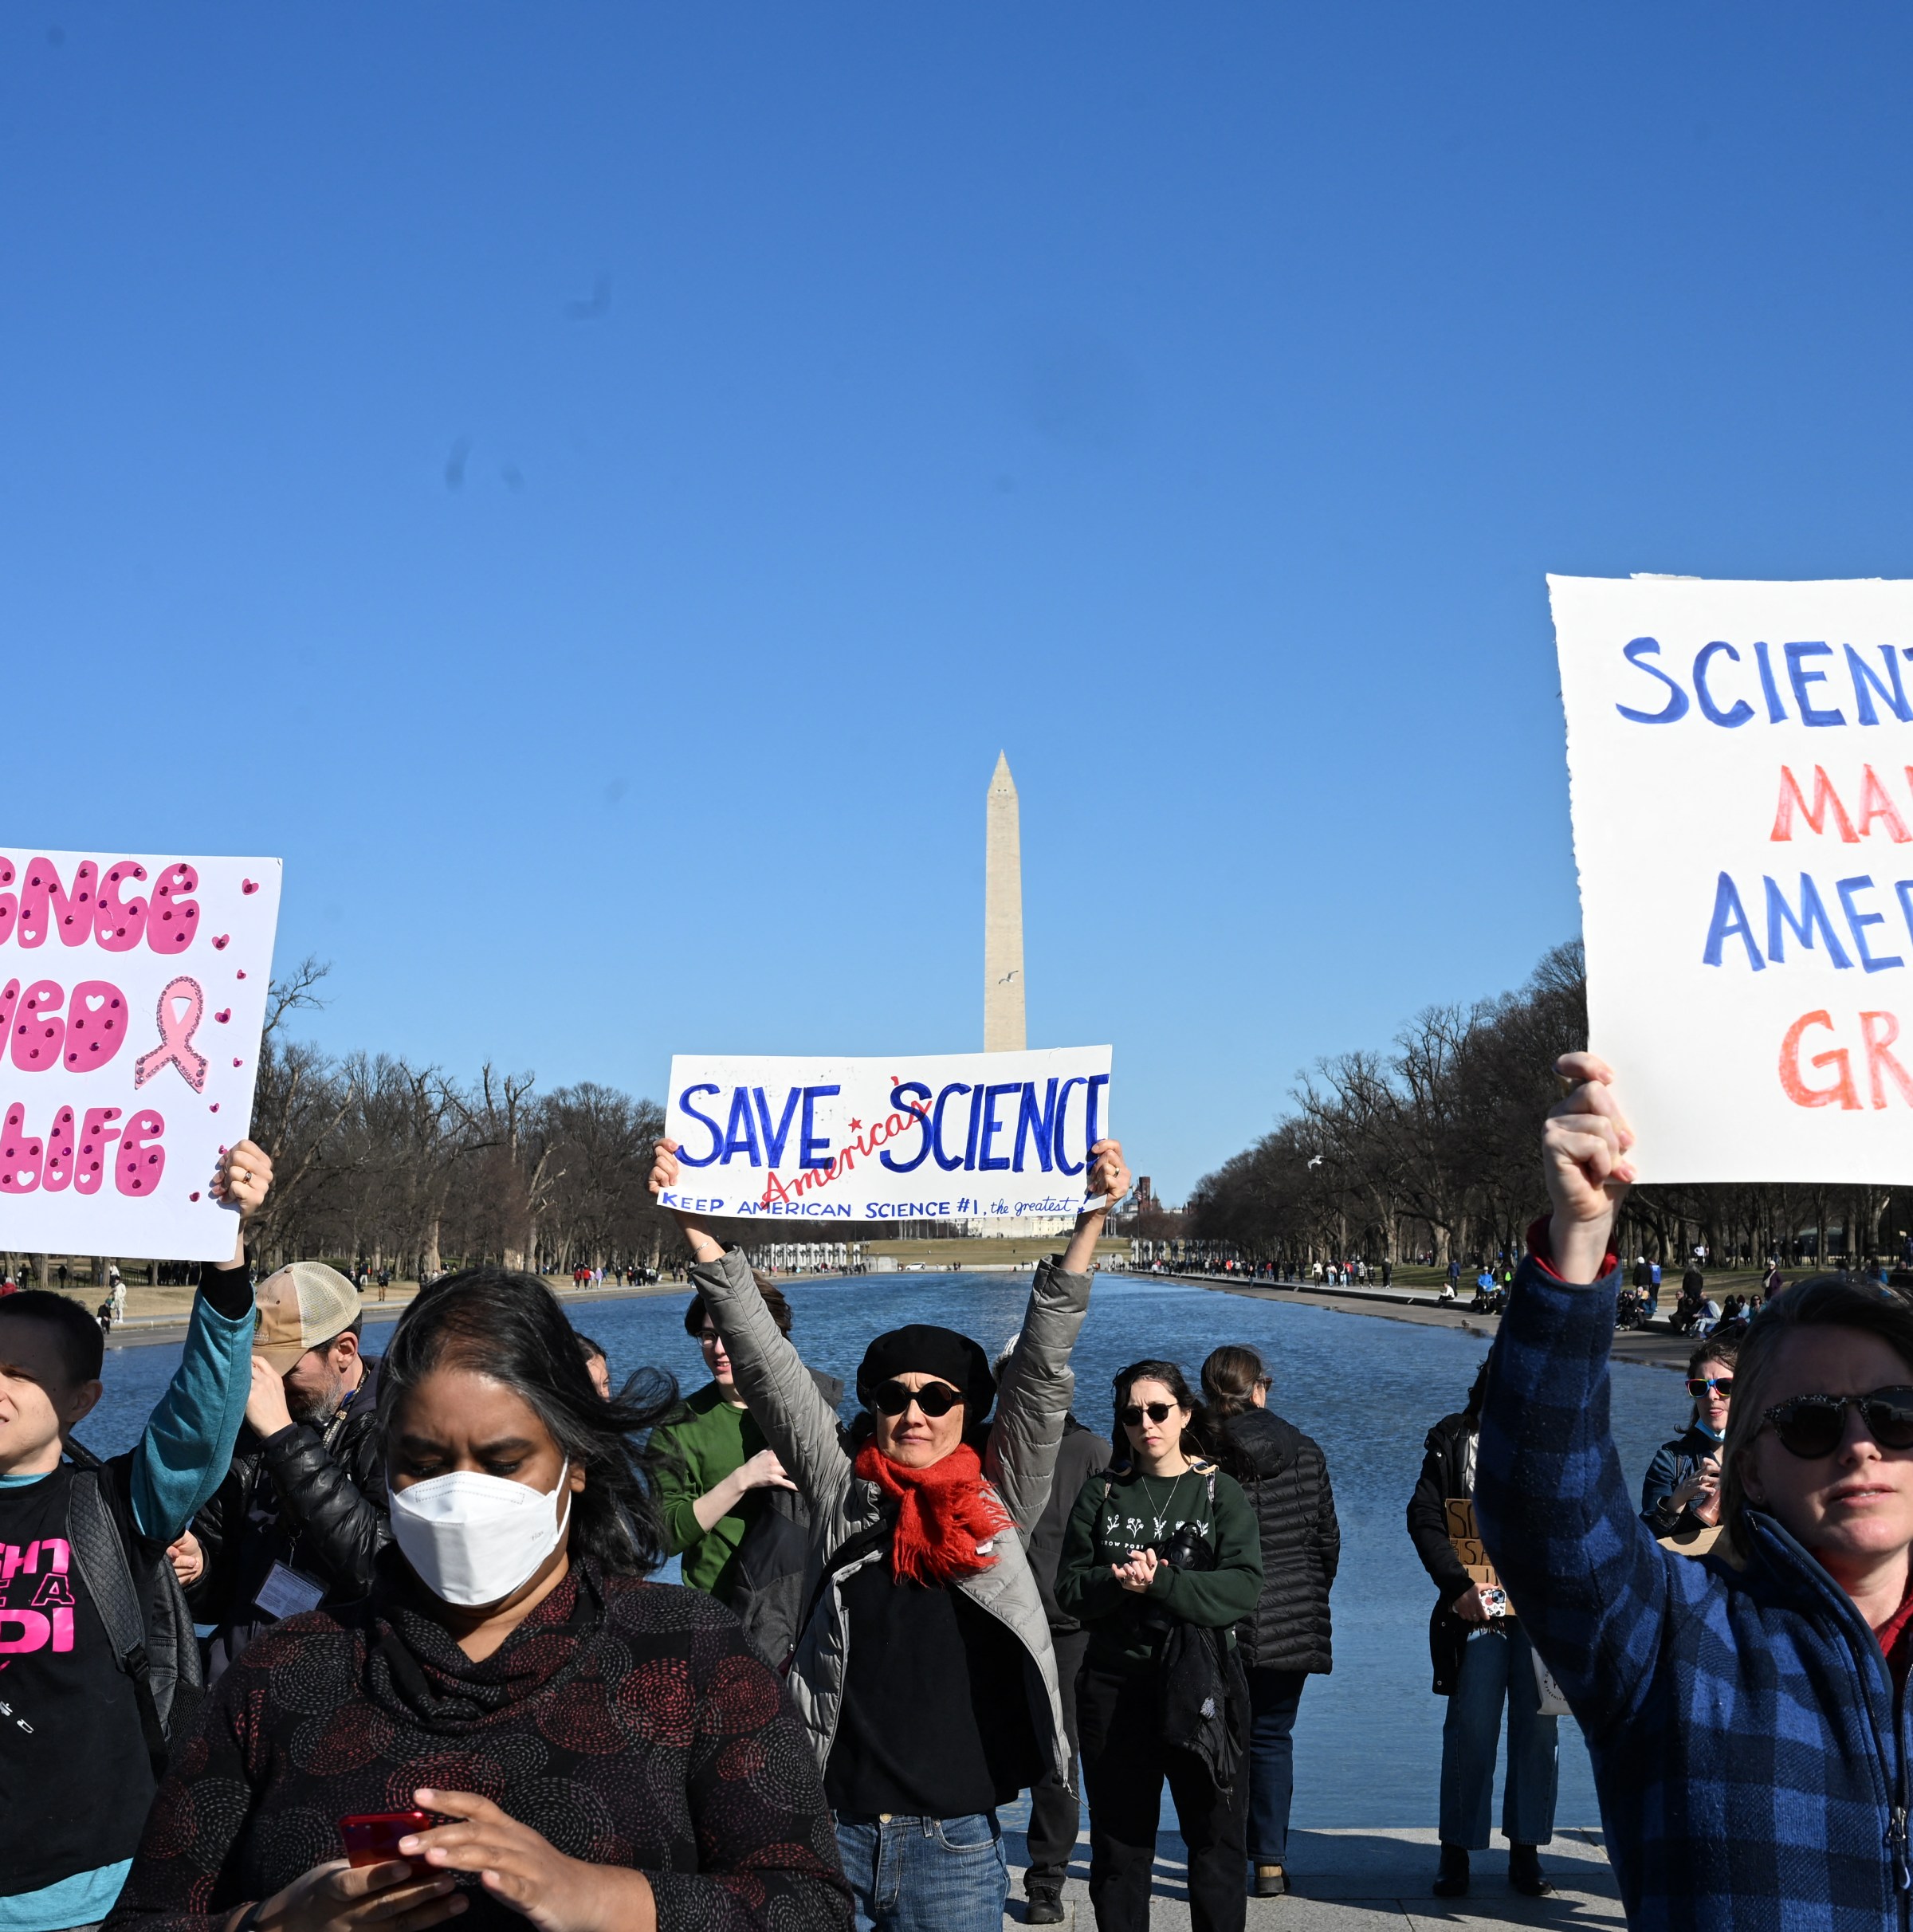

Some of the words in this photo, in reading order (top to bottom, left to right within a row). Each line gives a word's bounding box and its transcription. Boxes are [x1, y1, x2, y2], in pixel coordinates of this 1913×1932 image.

[1616, 637, 1913, 728] SCIEN
[1771, 764, 1913, 844] MA
[674, 1083, 841, 1169] SAVE
[662, 1192, 725, 1212] KEEP
[737, 1200, 851, 1218] AMERICAN
[865, 1201, 950, 1219] SCIENCE
[991, 1198, 1009, 1215] the
[30, 1573, 76, 1607] A
